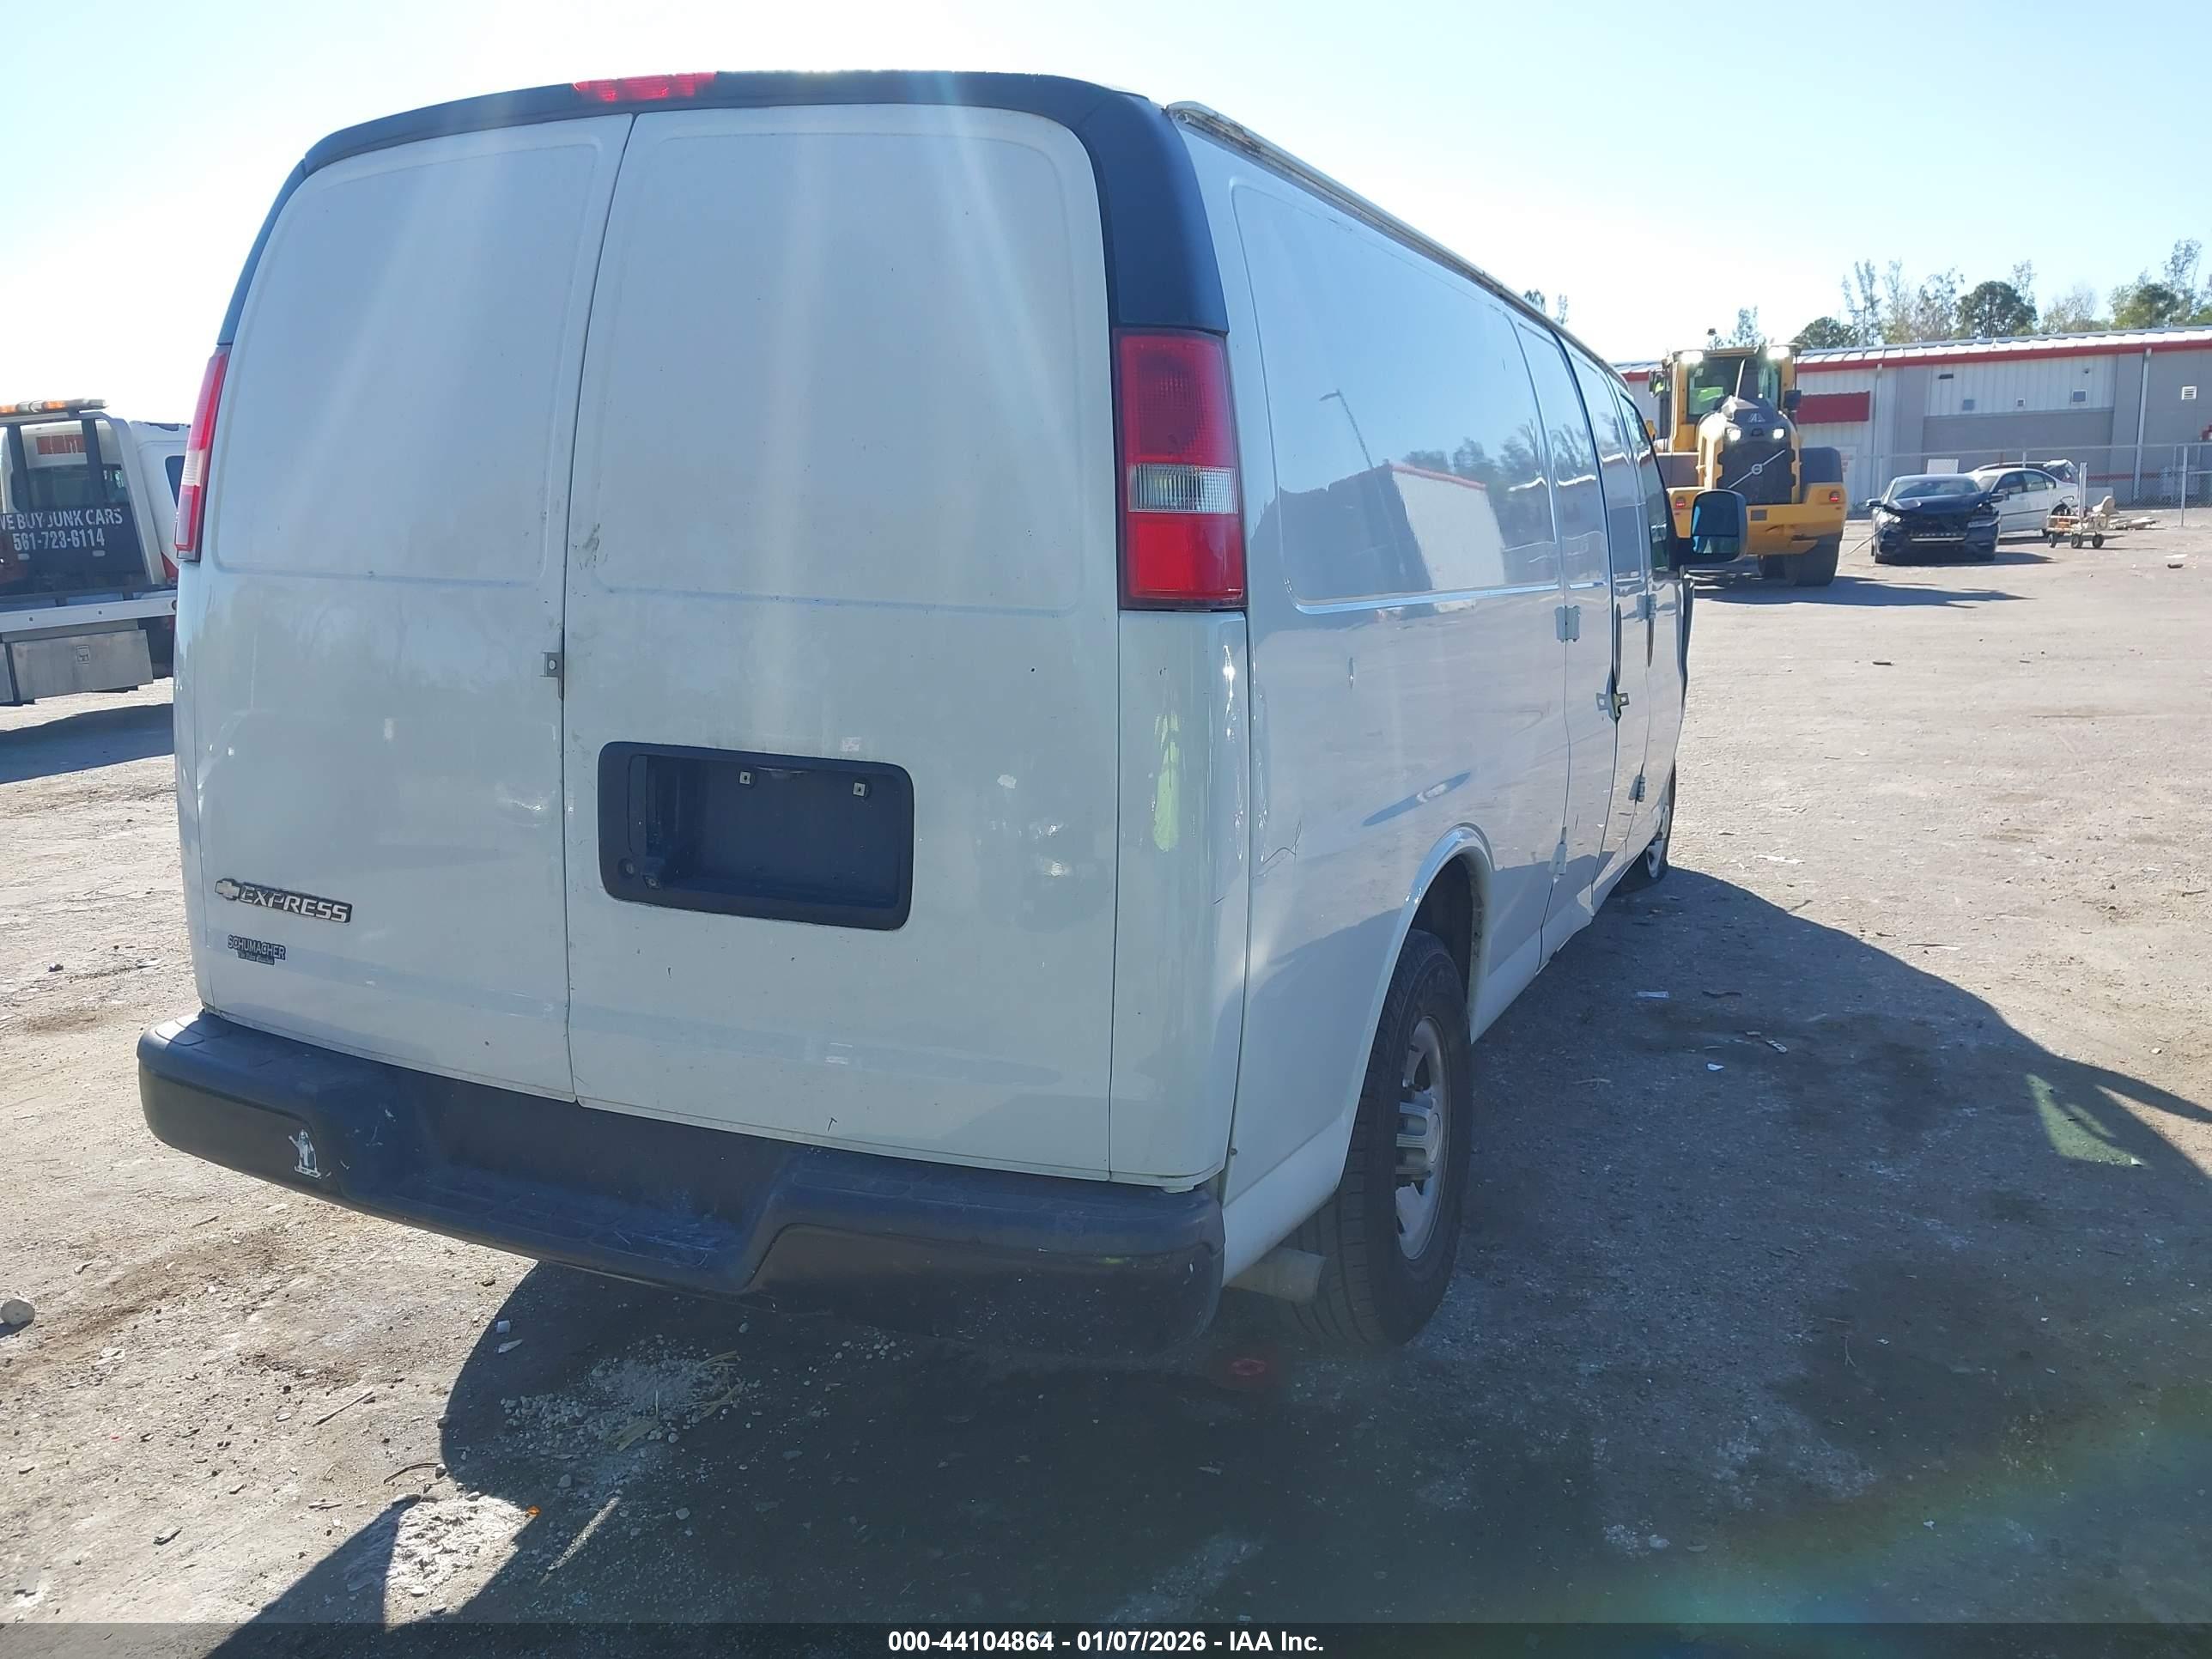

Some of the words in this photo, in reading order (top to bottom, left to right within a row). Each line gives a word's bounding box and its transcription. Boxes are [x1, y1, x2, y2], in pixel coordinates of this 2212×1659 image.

[17, 513, 43, 530] BUY
[47, 510, 83, 528] JUNK
[86, 508, 123, 526] CARS
[12, 528, 105, 550] 561-723-6114
[240, 884, 349, 923] EXPRESS
[228, 934, 286, 960] SCHUMACHER
